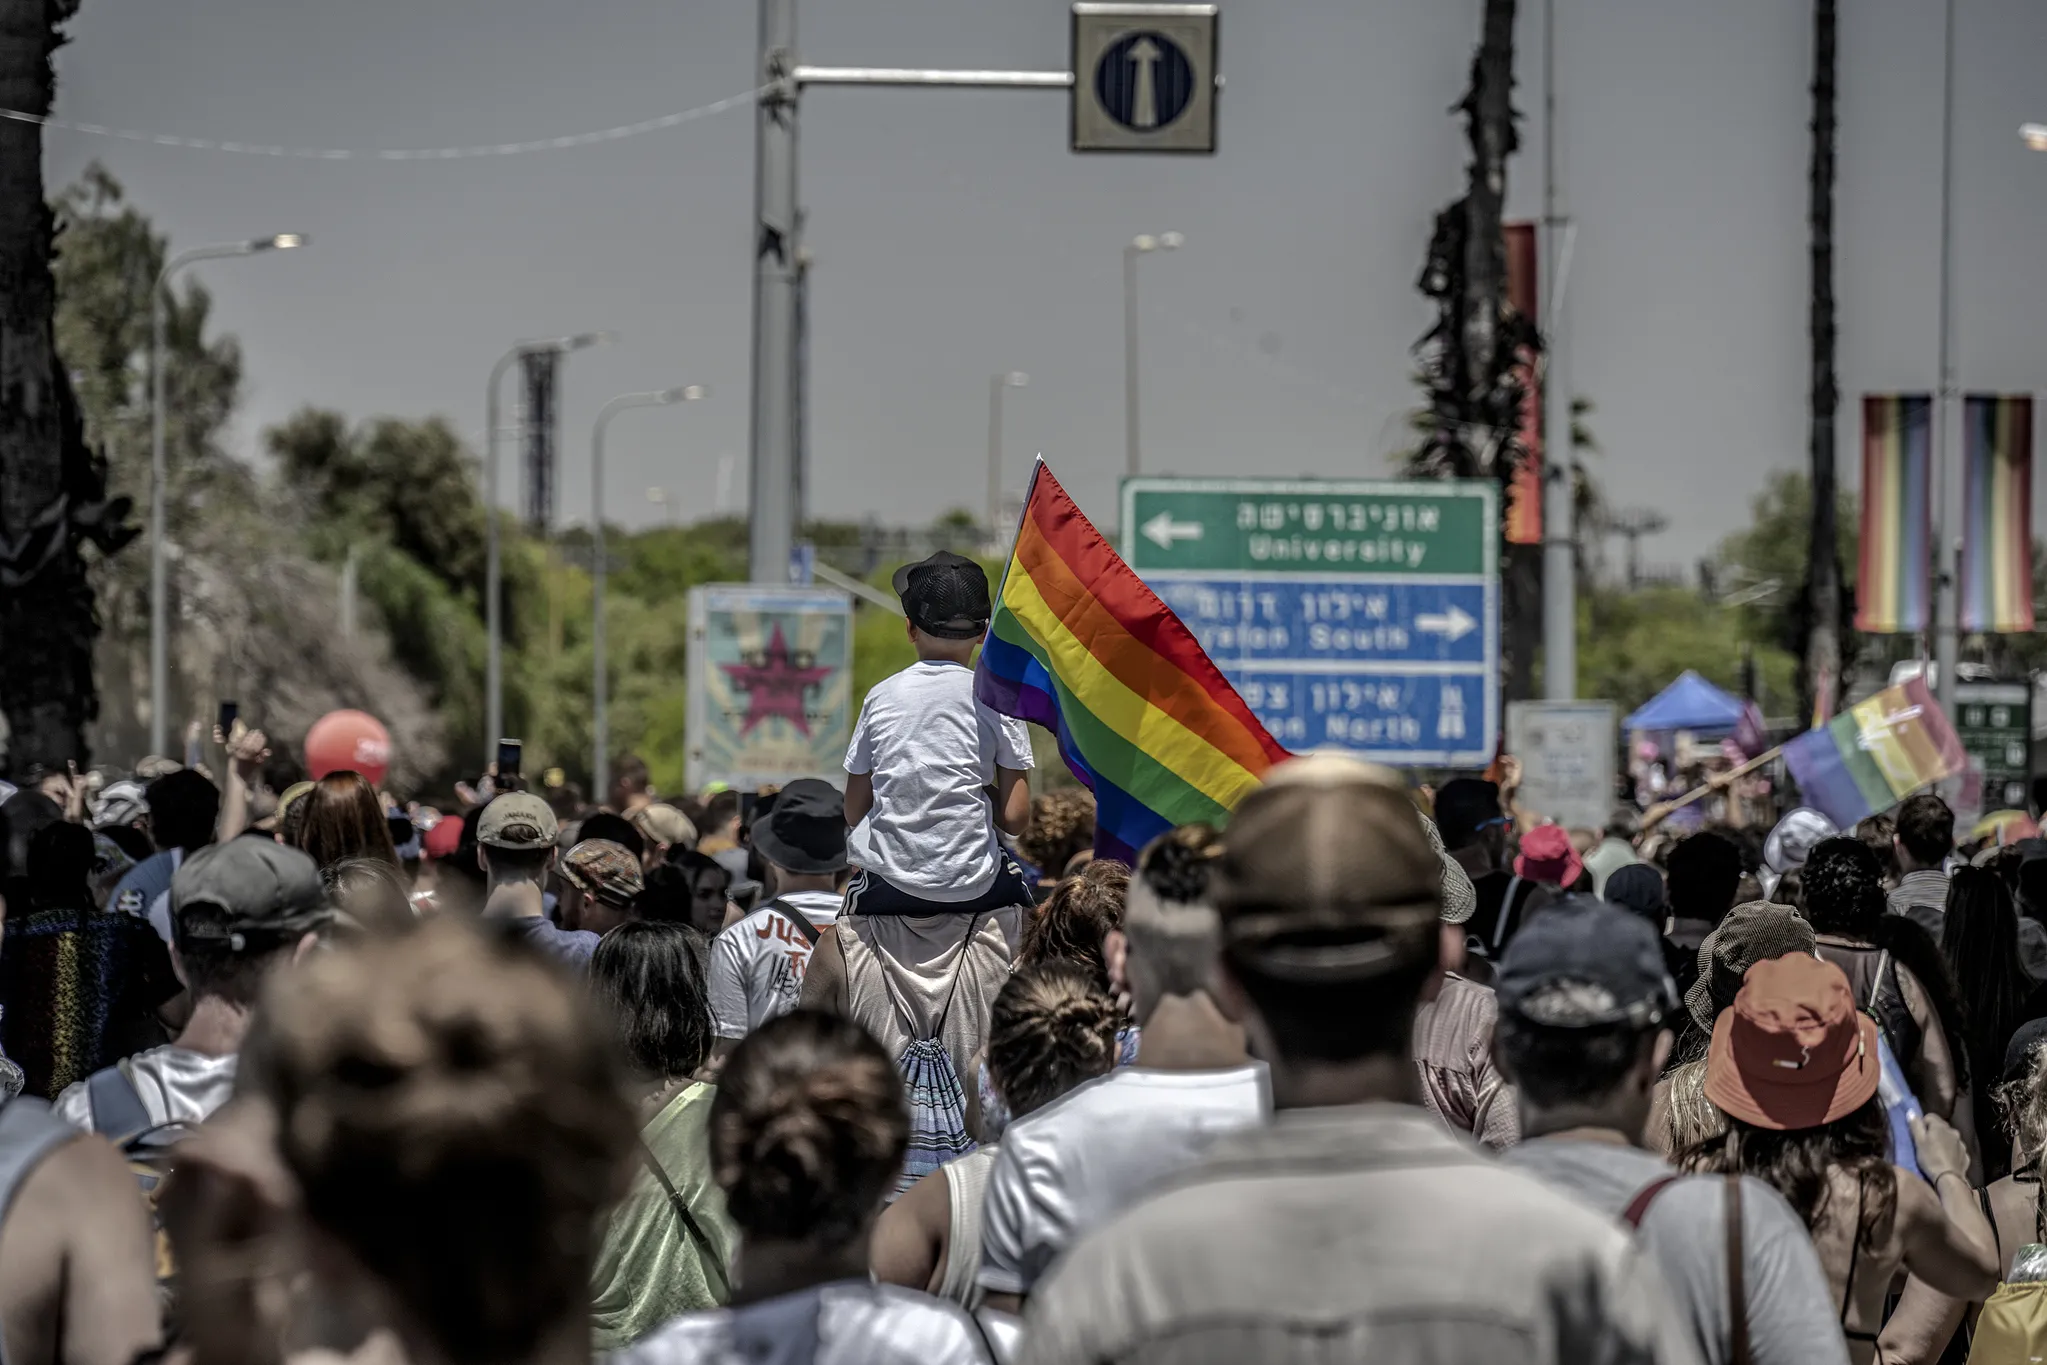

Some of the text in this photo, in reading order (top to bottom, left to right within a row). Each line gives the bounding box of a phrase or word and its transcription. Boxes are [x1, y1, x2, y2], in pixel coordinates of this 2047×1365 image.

[1237, 502, 1440, 531] אוניברסיטה
[1250, 533, 1427, 567] University
[1199, 587, 1388, 622] אילון דרום
[1194, 622, 1409, 652] yalon South
[1311, 680, 1400, 713] אילון
[1325, 713, 1421, 741] North
